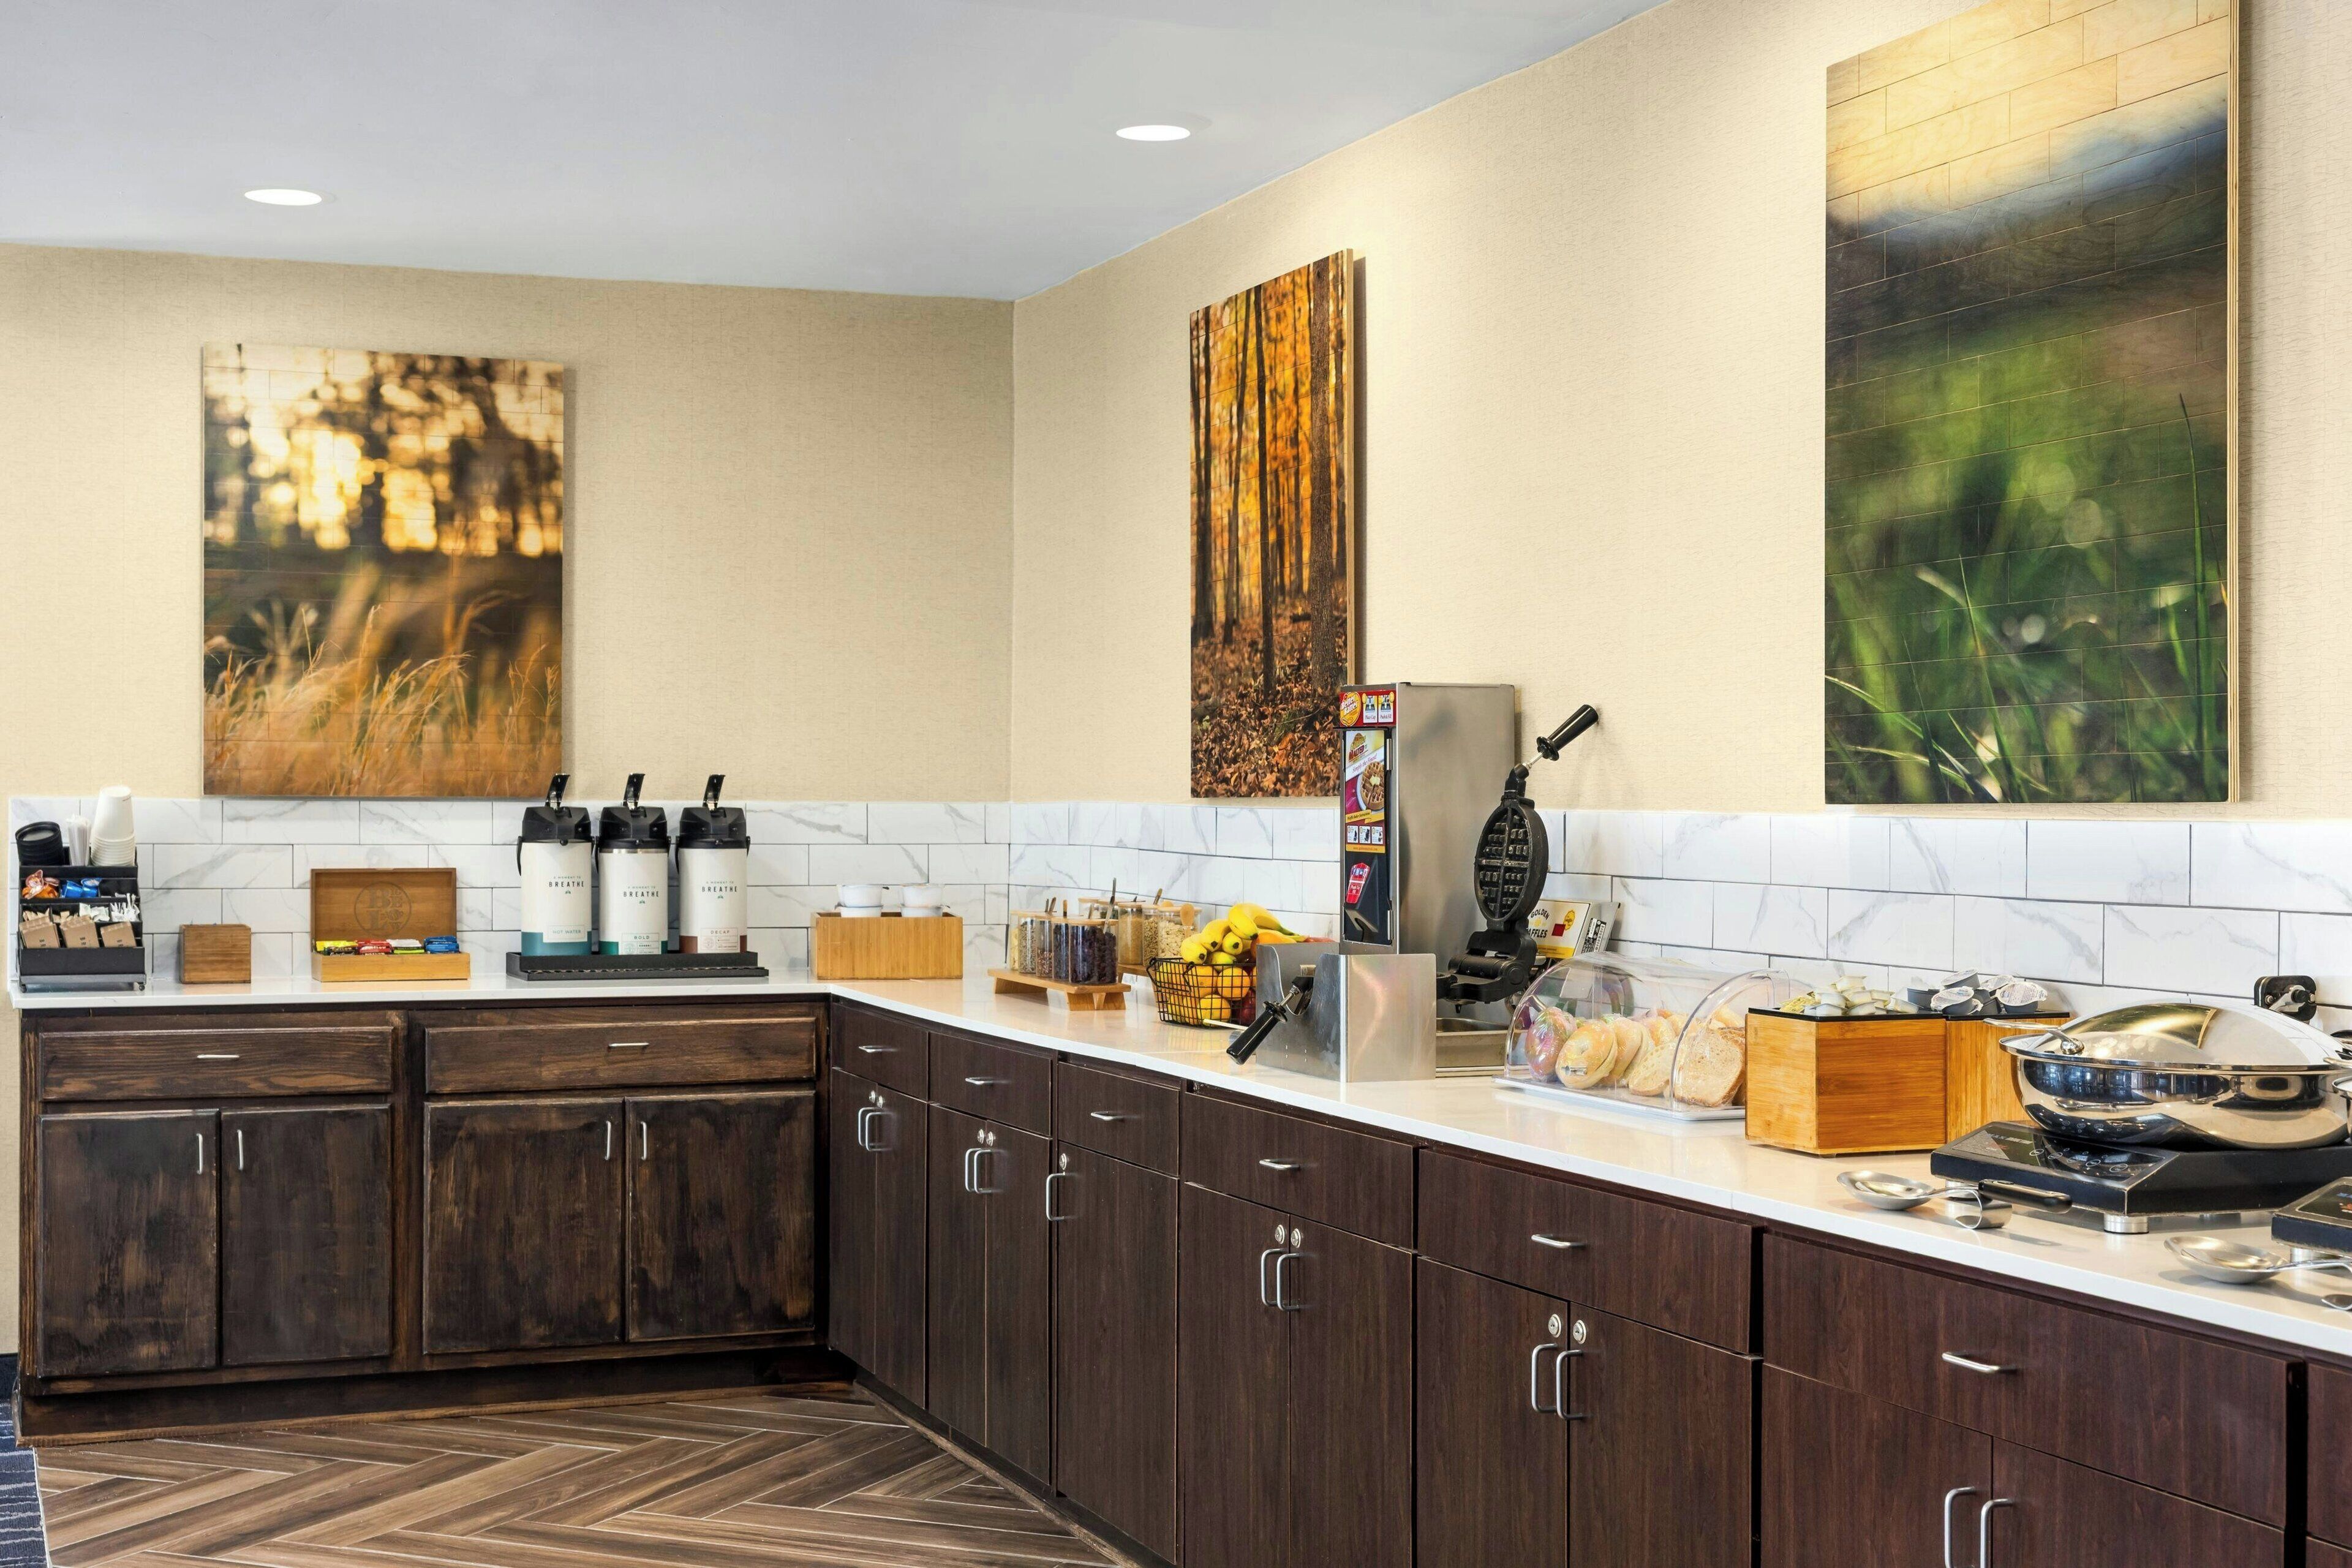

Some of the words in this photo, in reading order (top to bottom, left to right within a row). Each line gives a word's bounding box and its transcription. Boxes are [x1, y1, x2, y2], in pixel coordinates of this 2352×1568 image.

[1349, 745, 1365, 761] MALTED
[1531, 908, 1550, 920] GOLDEN
[1526, 927, 1548, 938] AFFLES
